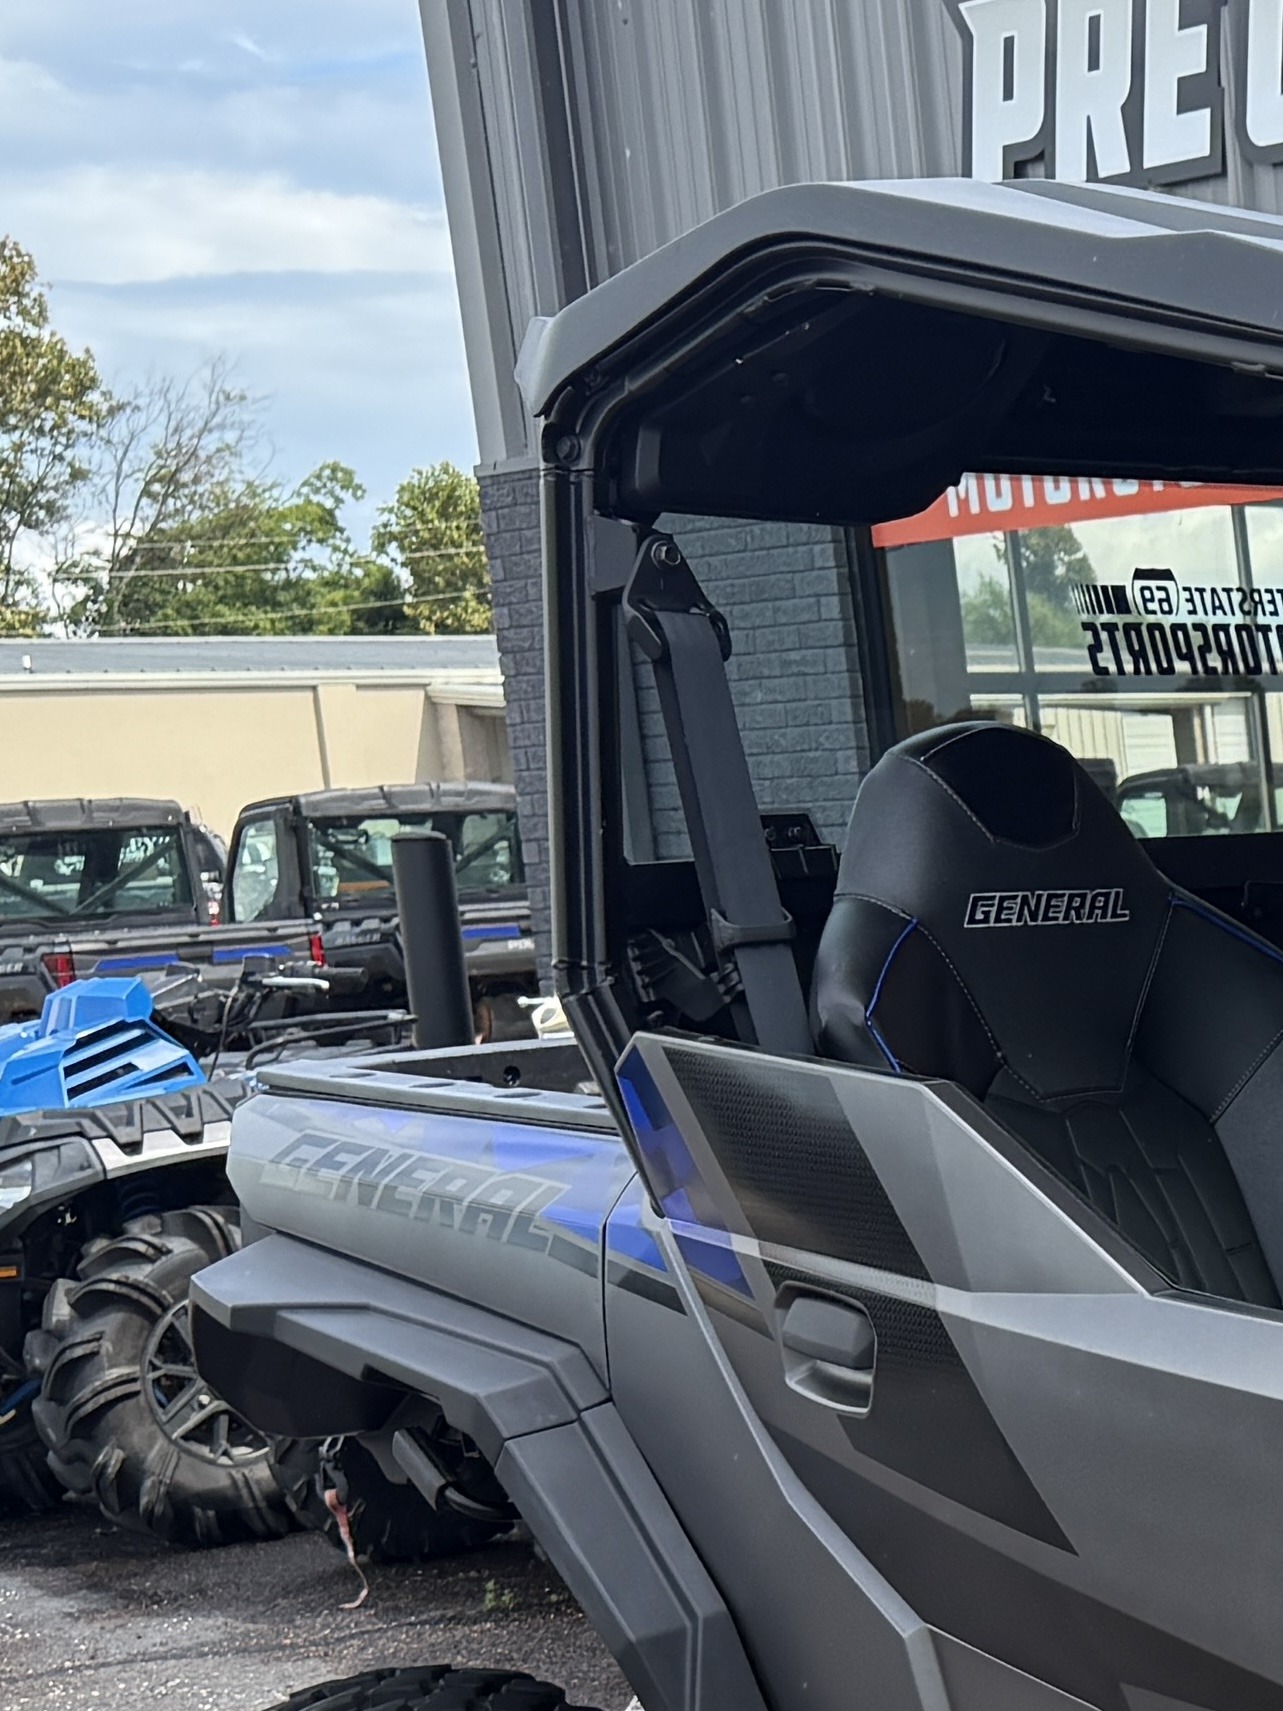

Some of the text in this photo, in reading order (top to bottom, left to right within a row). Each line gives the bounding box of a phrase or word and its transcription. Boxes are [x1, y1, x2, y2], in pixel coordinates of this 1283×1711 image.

[960, 0, 1213, 181] PRE
[964, 888, 1130, 928] GENERAL
[259, 1129, 574, 1253] GENERAL
